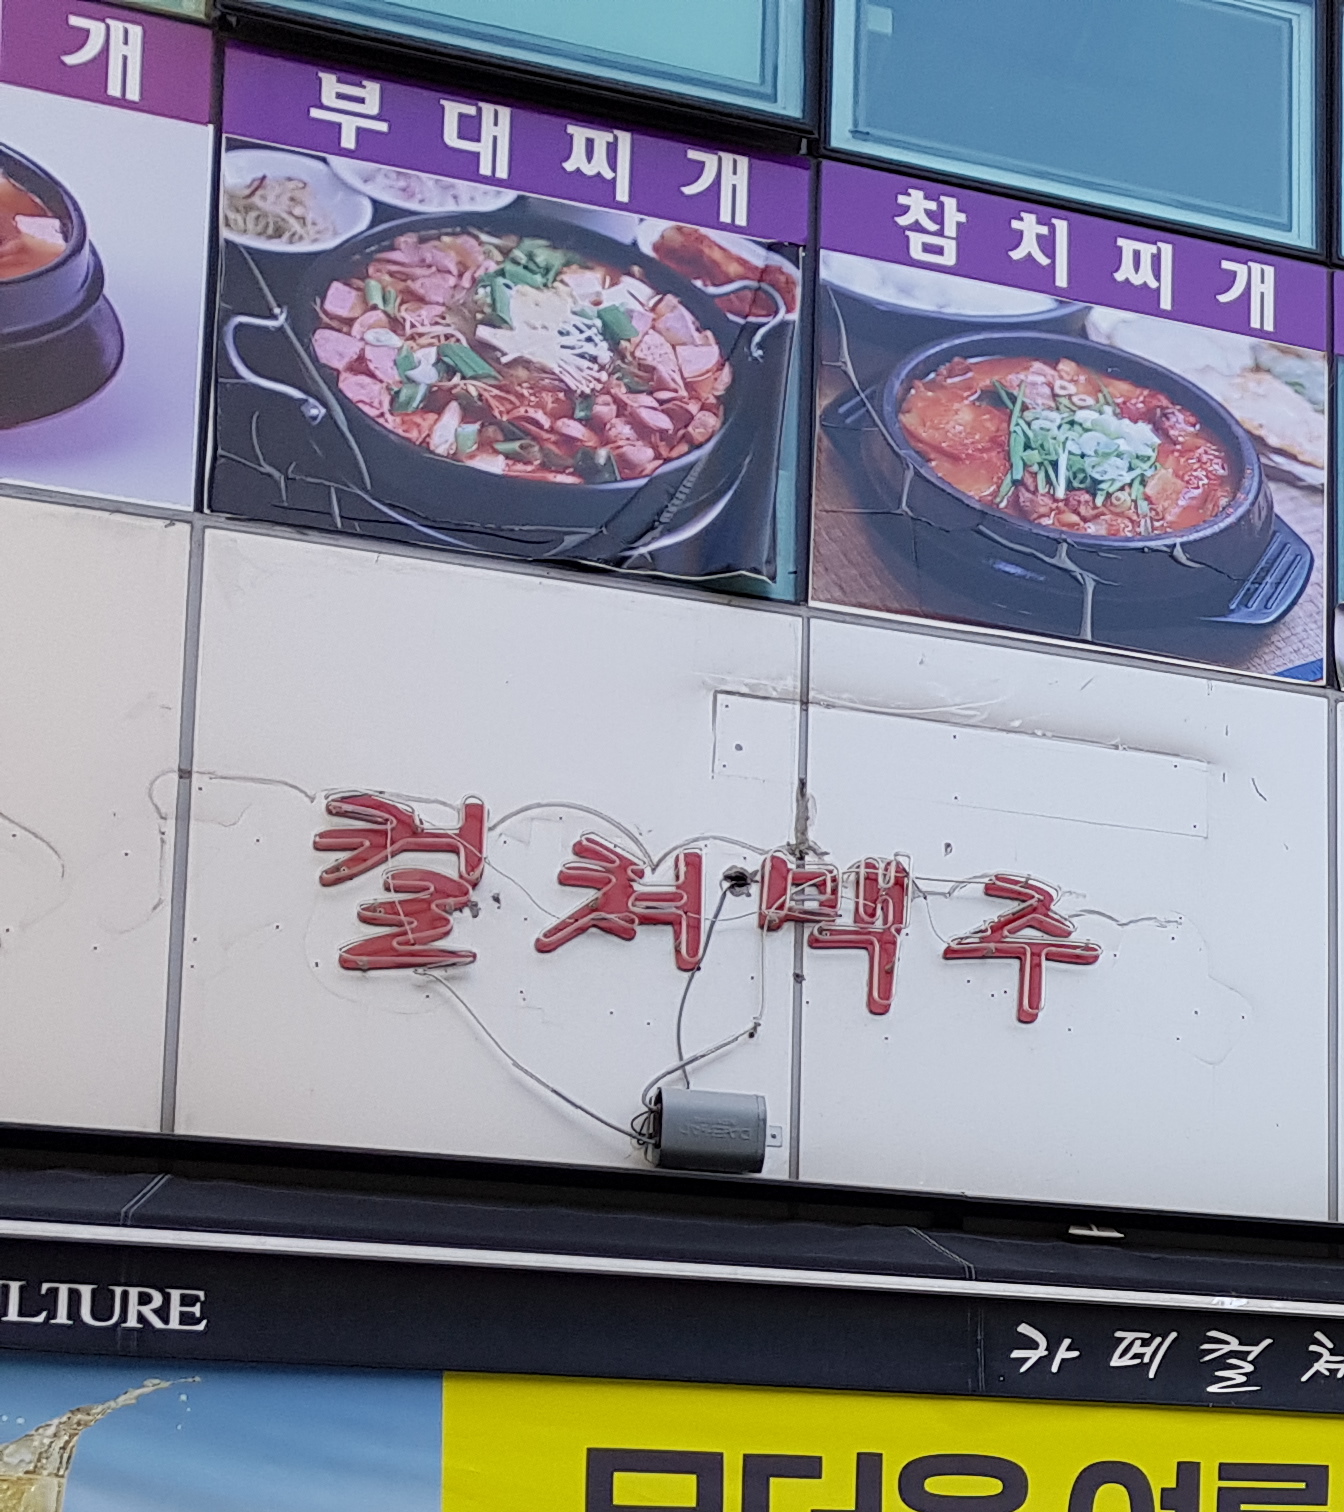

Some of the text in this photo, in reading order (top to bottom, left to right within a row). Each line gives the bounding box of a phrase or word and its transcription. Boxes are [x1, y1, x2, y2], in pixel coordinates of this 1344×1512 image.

[62, 14, 143, 103] 개
[309, 71, 750, 228] 부대찌개
[894, 188, 1277, 332] 참치찌개
[313, 795, 1103, 1024] 컬쳐맥주
